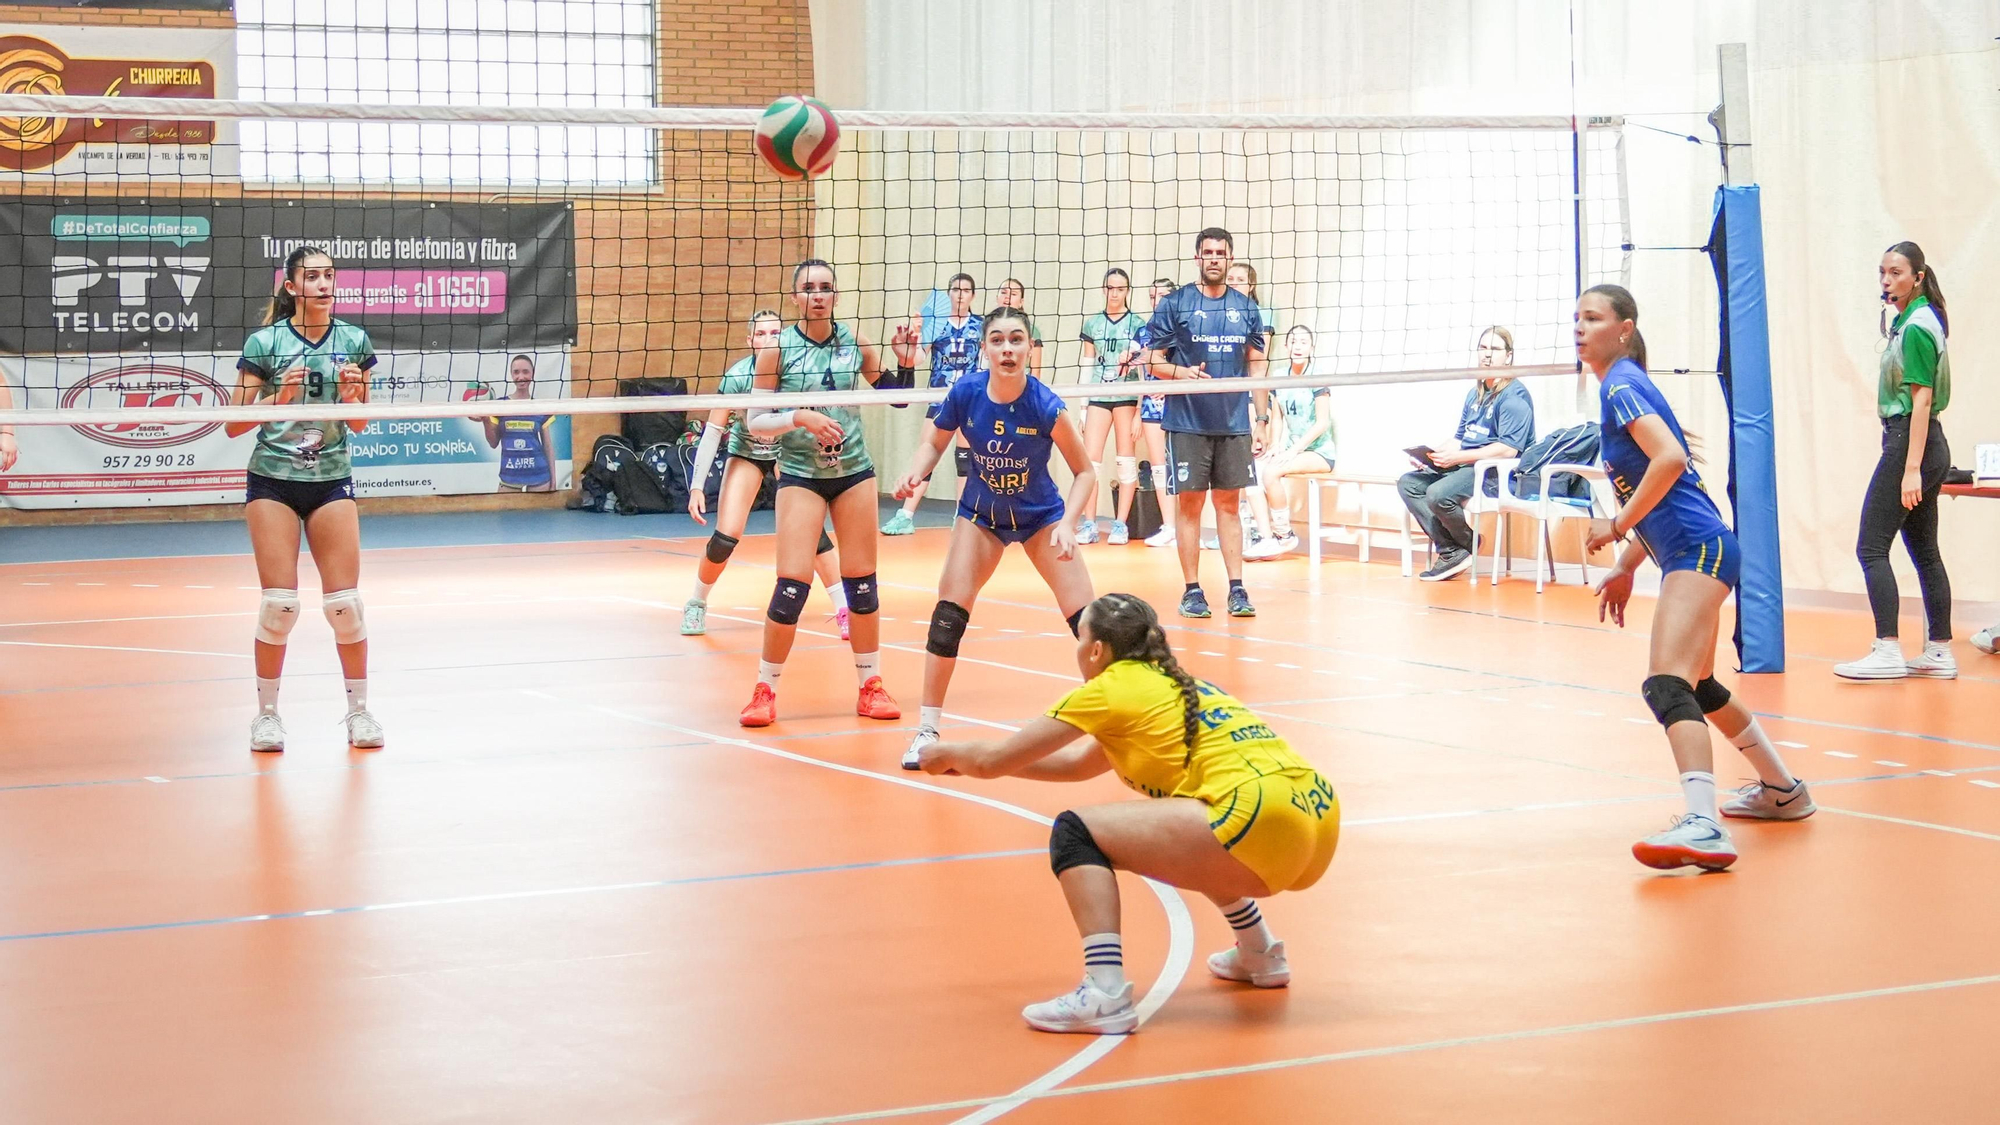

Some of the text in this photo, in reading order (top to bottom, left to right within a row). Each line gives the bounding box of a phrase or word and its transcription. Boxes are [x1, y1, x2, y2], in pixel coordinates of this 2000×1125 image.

[130, 68, 202, 85] CHURRERIA
[130, 126, 178, 139] Desde
[63, 221, 198, 235] #DeTotalConfianza
[261, 235, 281, 258] Tu
[371, 236, 391, 259] de
[467, 242, 478, 263] y
[481, 238, 517, 260] fibra
[52, 256, 211, 306] PTV
[365, 285, 408, 307] gratis
[414, 276, 434, 308] al
[437, 276, 490, 308] 1650
[52, 312, 199, 333] TELECOM
[1105, 338, 1117, 352] 10
[105, 382, 190, 392] TALLERES
[309, 371, 323, 398] 9
[1286, 400, 1297, 415] 14
[362, 422, 384, 435] DEL
[389, 421, 443, 436] DEPORTE
[994, 420, 1005, 435] 5
[403, 443, 420, 457] TU
[103, 454, 195, 468] 957 29 90 28
